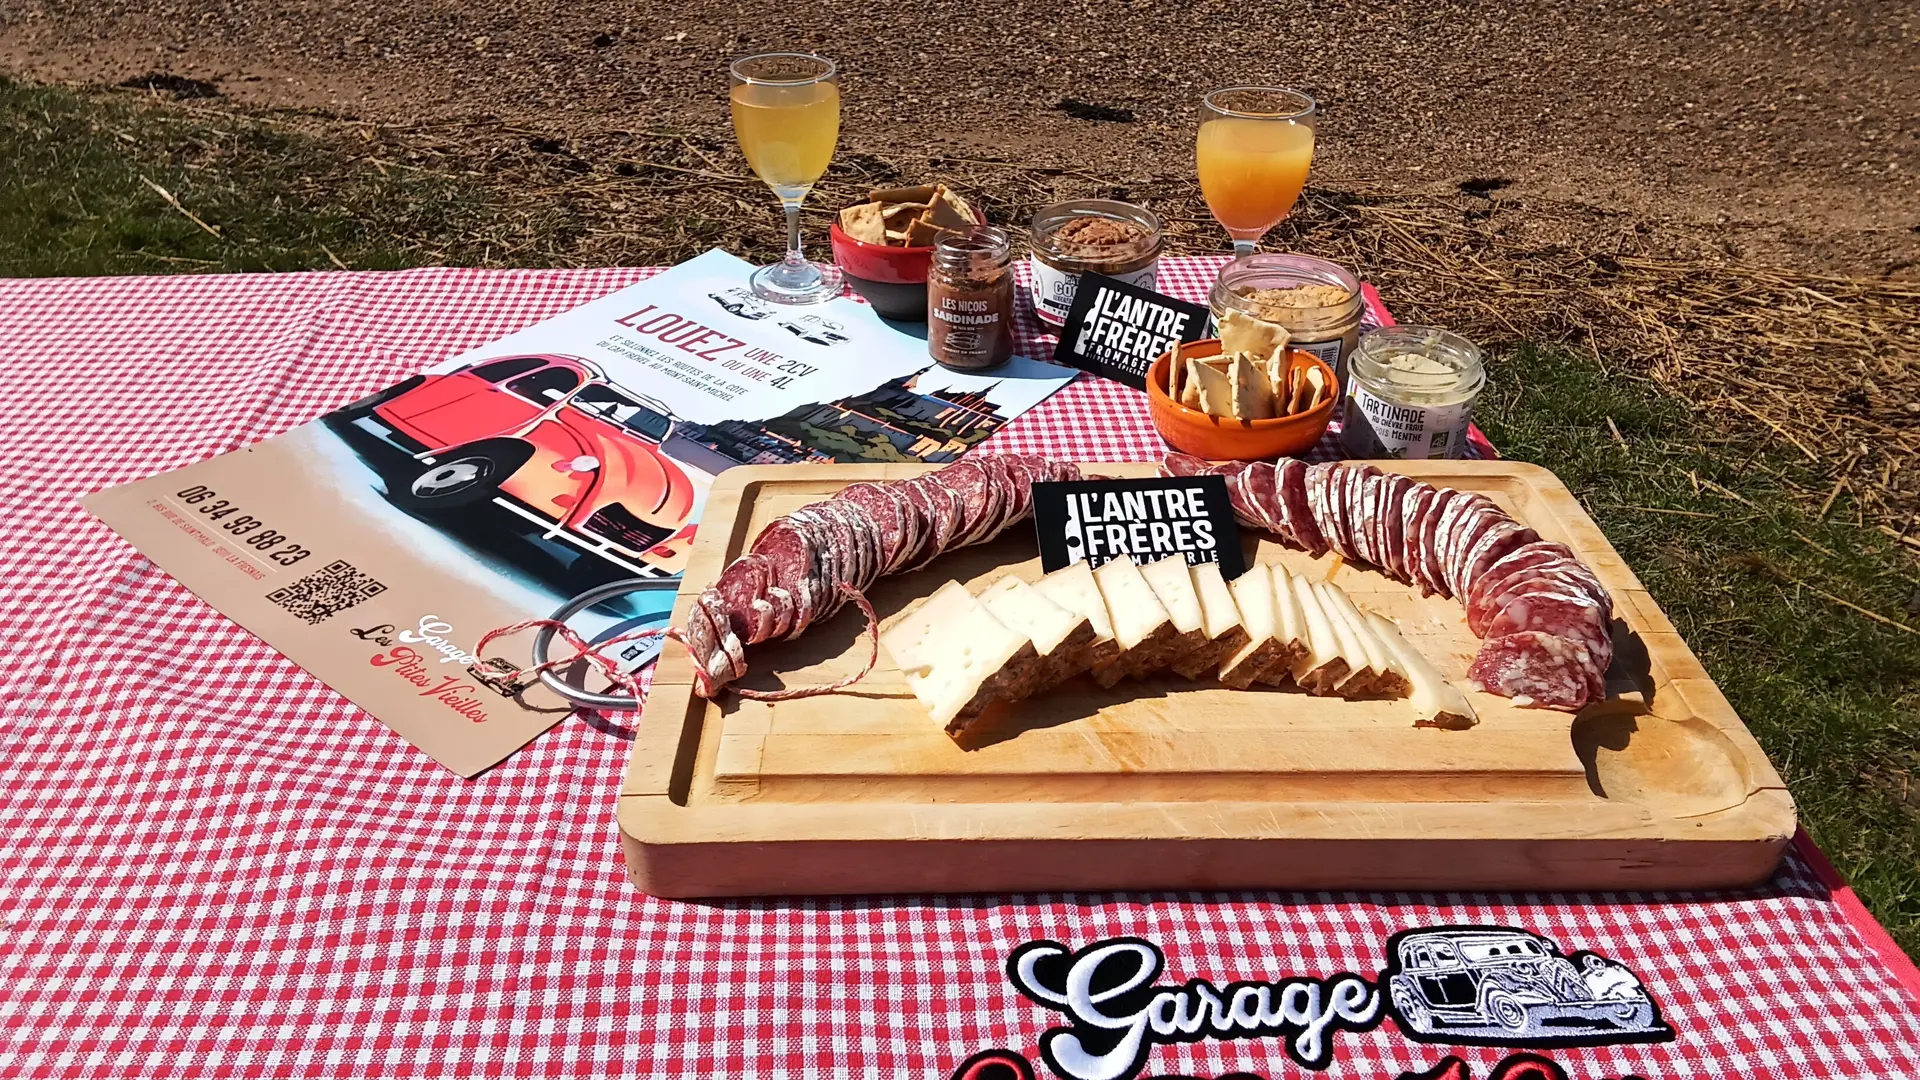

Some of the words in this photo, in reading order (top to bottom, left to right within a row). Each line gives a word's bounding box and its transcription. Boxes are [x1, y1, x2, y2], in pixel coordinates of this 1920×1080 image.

[933, 308, 999, 325] SARDINADE
[942, 297, 957, 311] LES
[958, 300, 988, 314] NIÇOIS
[1101, 288, 1190, 341] L'ANTRE
[614, 304, 747, 361] LOUEZ
[607, 345, 626, 353] CAP
[648, 362, 664, 370] AU
[656, 354, 675, 364] LES
[671, 360, 704, 376] ROUTES
[700, 373, 716, 381] DE
[713, 378, 727, 387] LA
[744, 347, 783, 366] UNE
[777, 359, 819, 378] 2CV
[1089, 342, 1153, 371] FROMAGE
[721, 359, 746, 371] OU
[741, 366, 773, 382] UNE
[769, 375, 795, 390] 4L
[1362, 393, 1426, 424] TARTINADE
[1391, 430, 1422, 442] MENTHE
[1405, 423, 1424, 432] FRAIS
[1080, 488, 1209, 523] L'ANTRE
[177, 485, 216, 504] 06
[199, 500, 239, 520] 34
[223, 515, 262, 535] 93
[246, 530, 287, 551] 88
[269, 544, 311, 566] 23
[1085, 519, 1217, 555] FRÈRES
[398, 614, 475, 664] Garage
[350, 624, 395, 647] Les
[418, 675, 488, 723] Vieilles
[1017, 944, 1380, 1080] Garage
